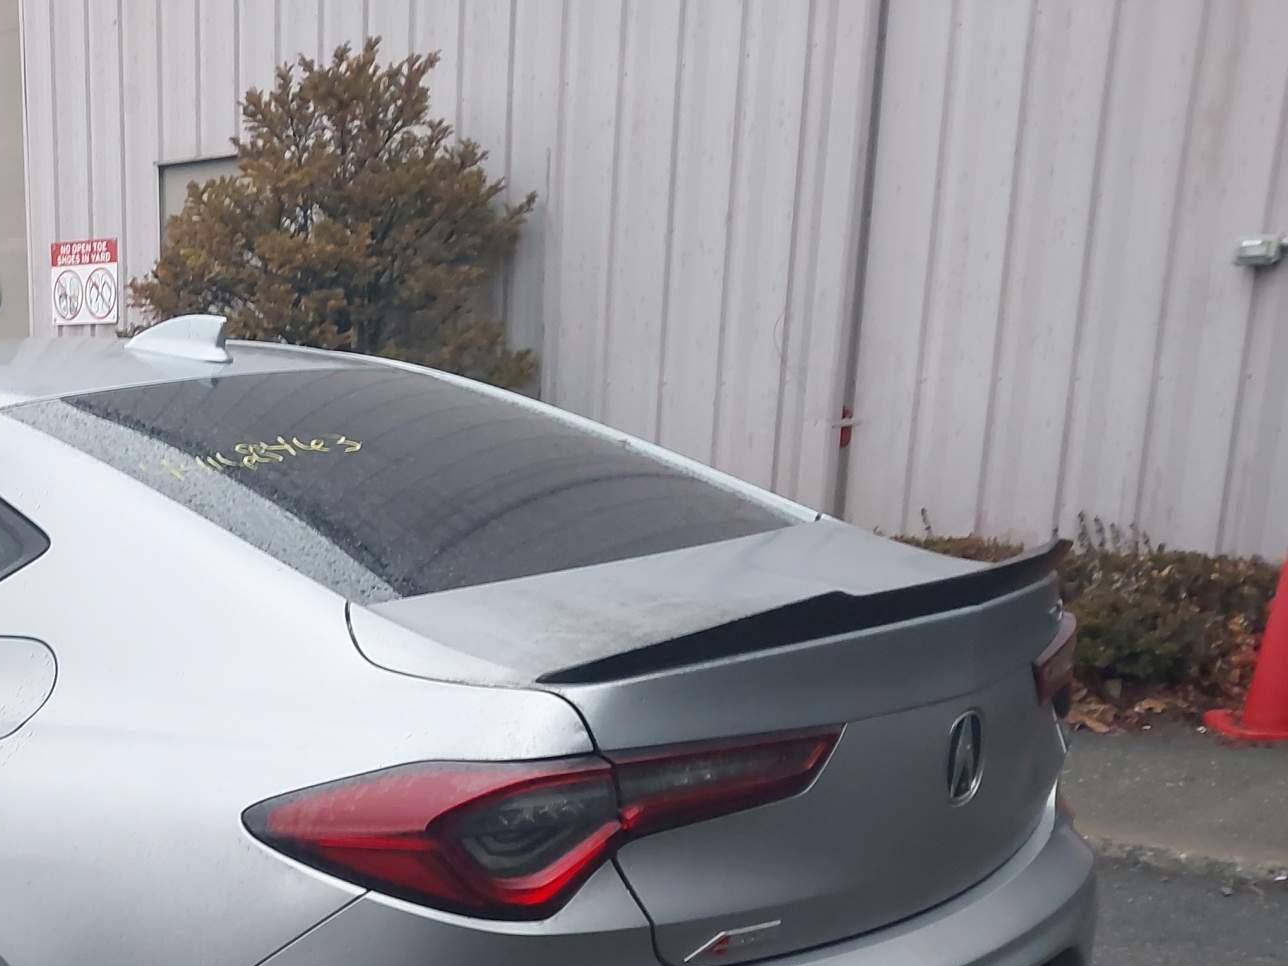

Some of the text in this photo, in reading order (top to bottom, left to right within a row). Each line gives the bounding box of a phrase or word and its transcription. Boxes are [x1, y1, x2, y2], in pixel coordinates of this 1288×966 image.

[60, 241, 107, 254] NO OPEN TOE
[57, 251, 111, 265] SHOES IN YARD
